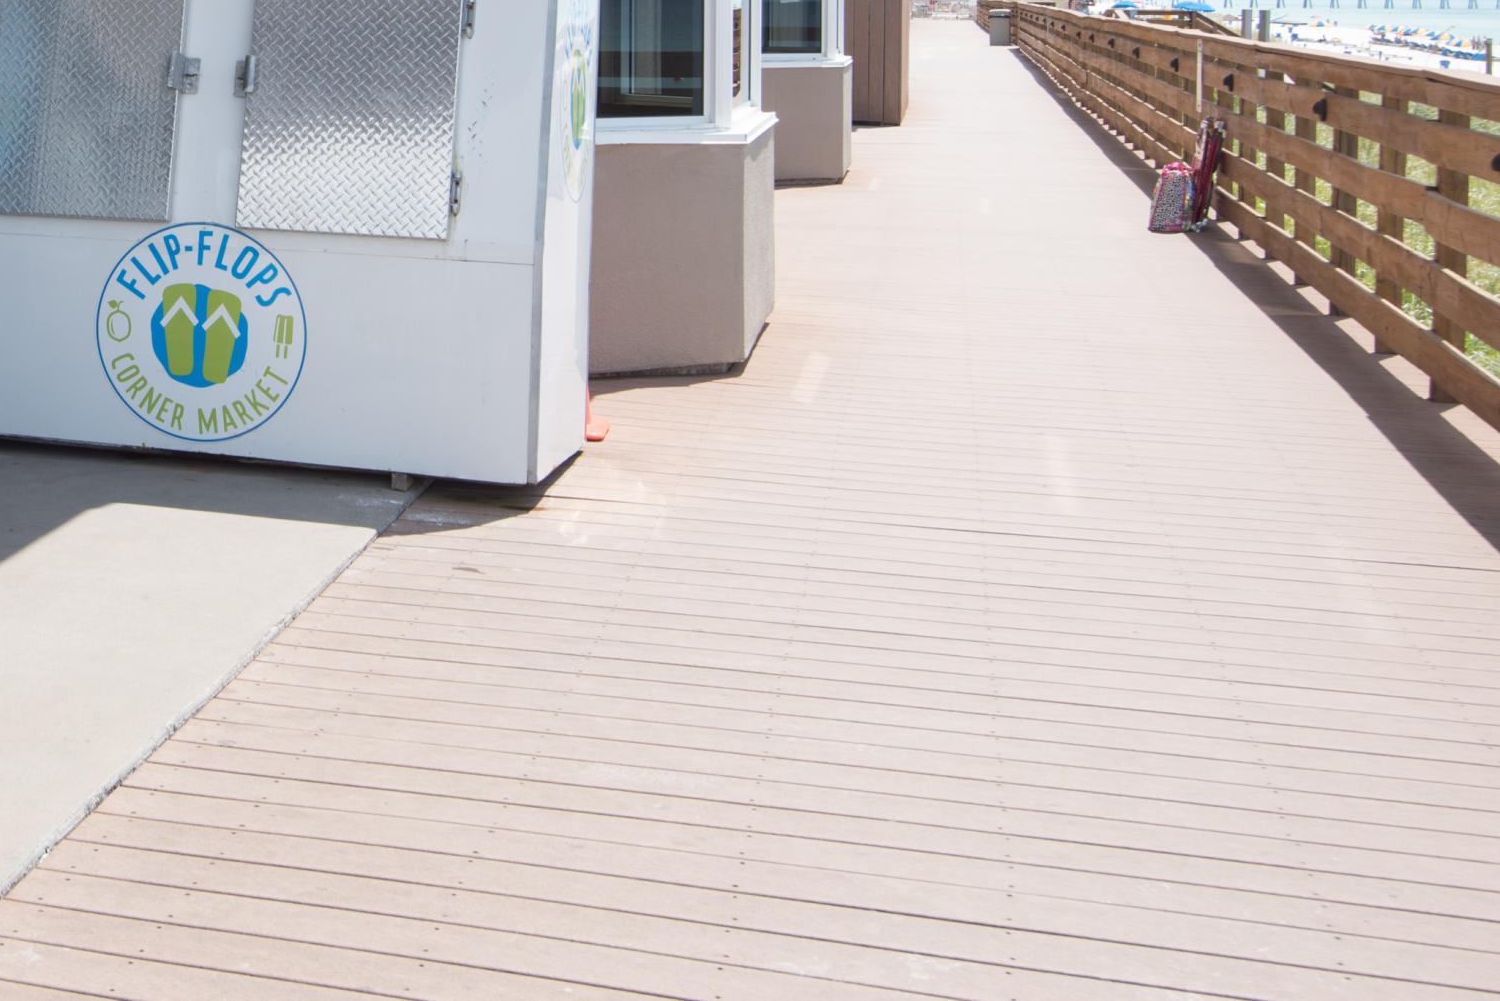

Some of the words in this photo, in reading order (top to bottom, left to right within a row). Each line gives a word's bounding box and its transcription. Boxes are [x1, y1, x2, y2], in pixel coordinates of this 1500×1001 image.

[117, 229, 291, 308] FLIP-FLOPS
[111, 352, 184, 432] CORNER
[199, 365, 289, 435] MARKET
